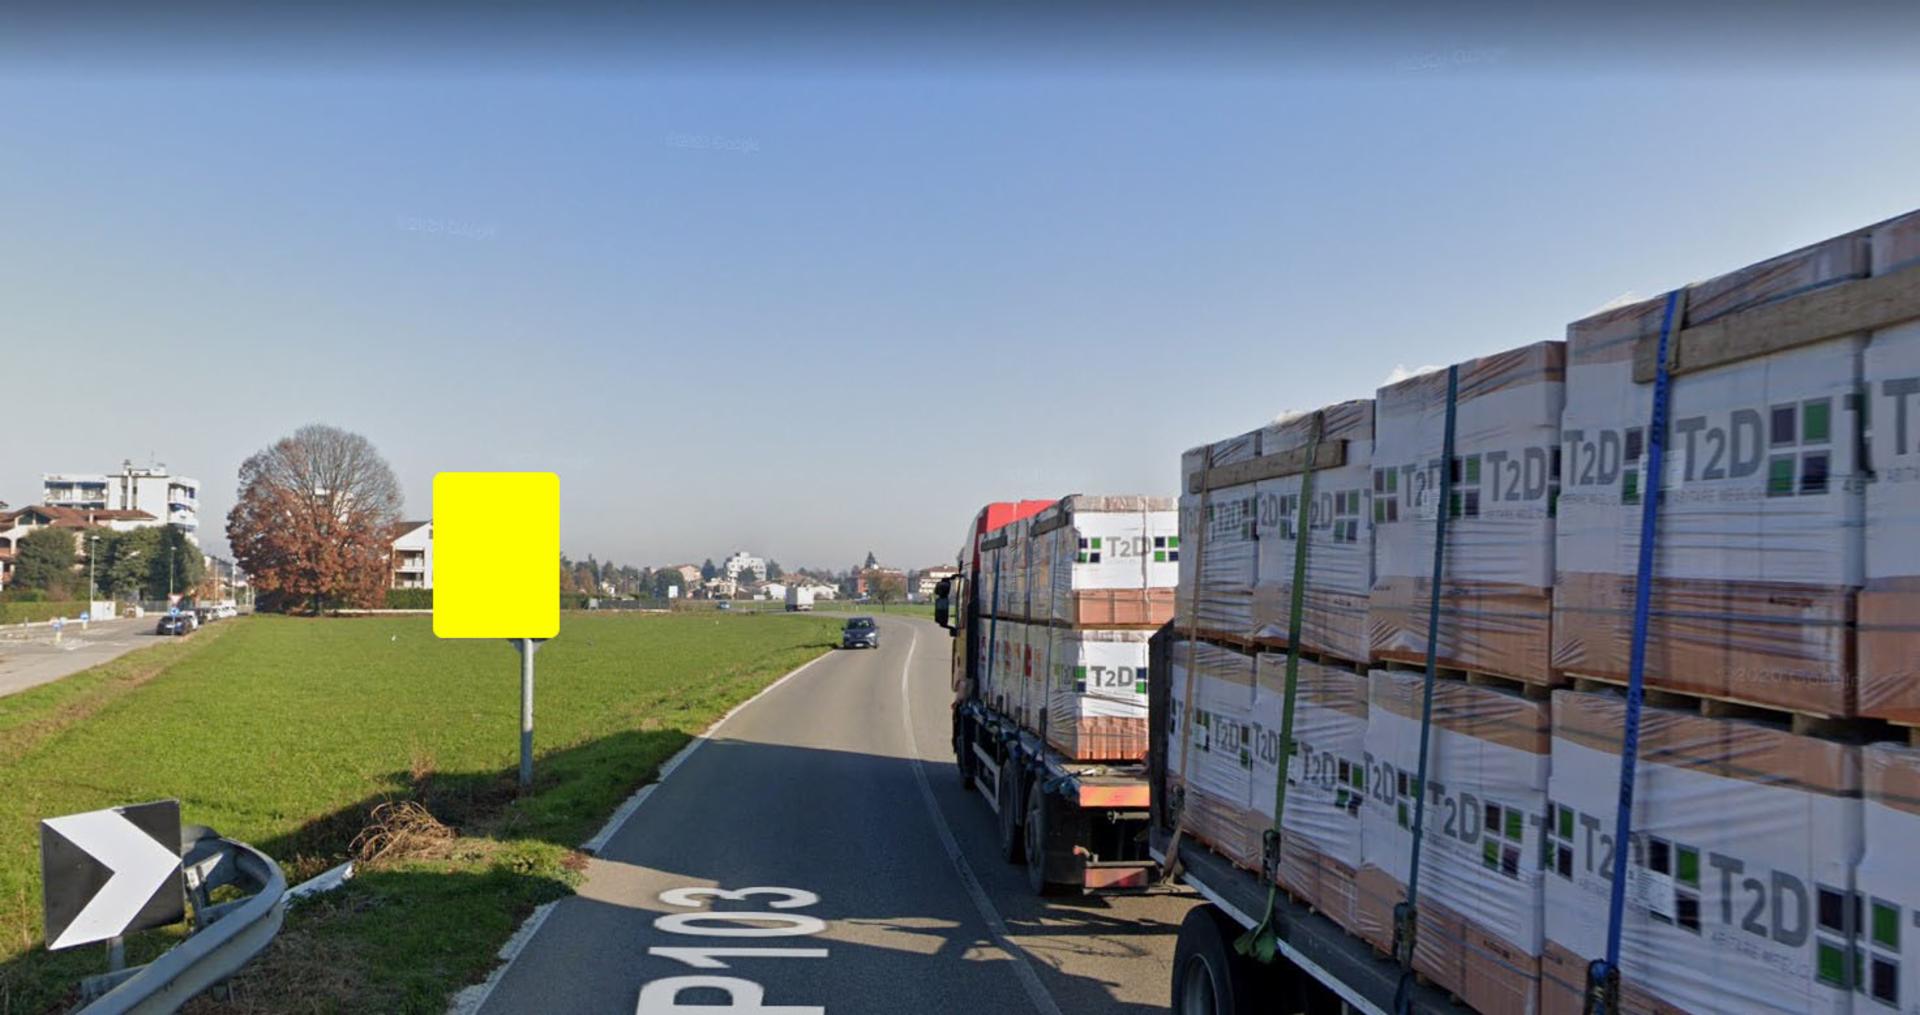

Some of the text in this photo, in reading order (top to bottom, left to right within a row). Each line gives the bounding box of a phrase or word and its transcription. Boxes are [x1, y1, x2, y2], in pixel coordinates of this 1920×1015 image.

[1563, 429, 1620, 486] T2D
[1677, 408, 1763, 482] T2D
[1486, 447, 1546, 501] T2D
[1105, 536, 1150, 558] T2D
[1091, 665, 1134, 687] T2D
[1212, 713, 1239, 754] T2D
[1252, 721, 1278, 765] T2D
[1300, 741, 1336, 792] T2D
[1363, 751, 1396, 807] T2D
[1427, 780, 1481, 845] T2D
[1709, 852, 1810, 949] T2D
